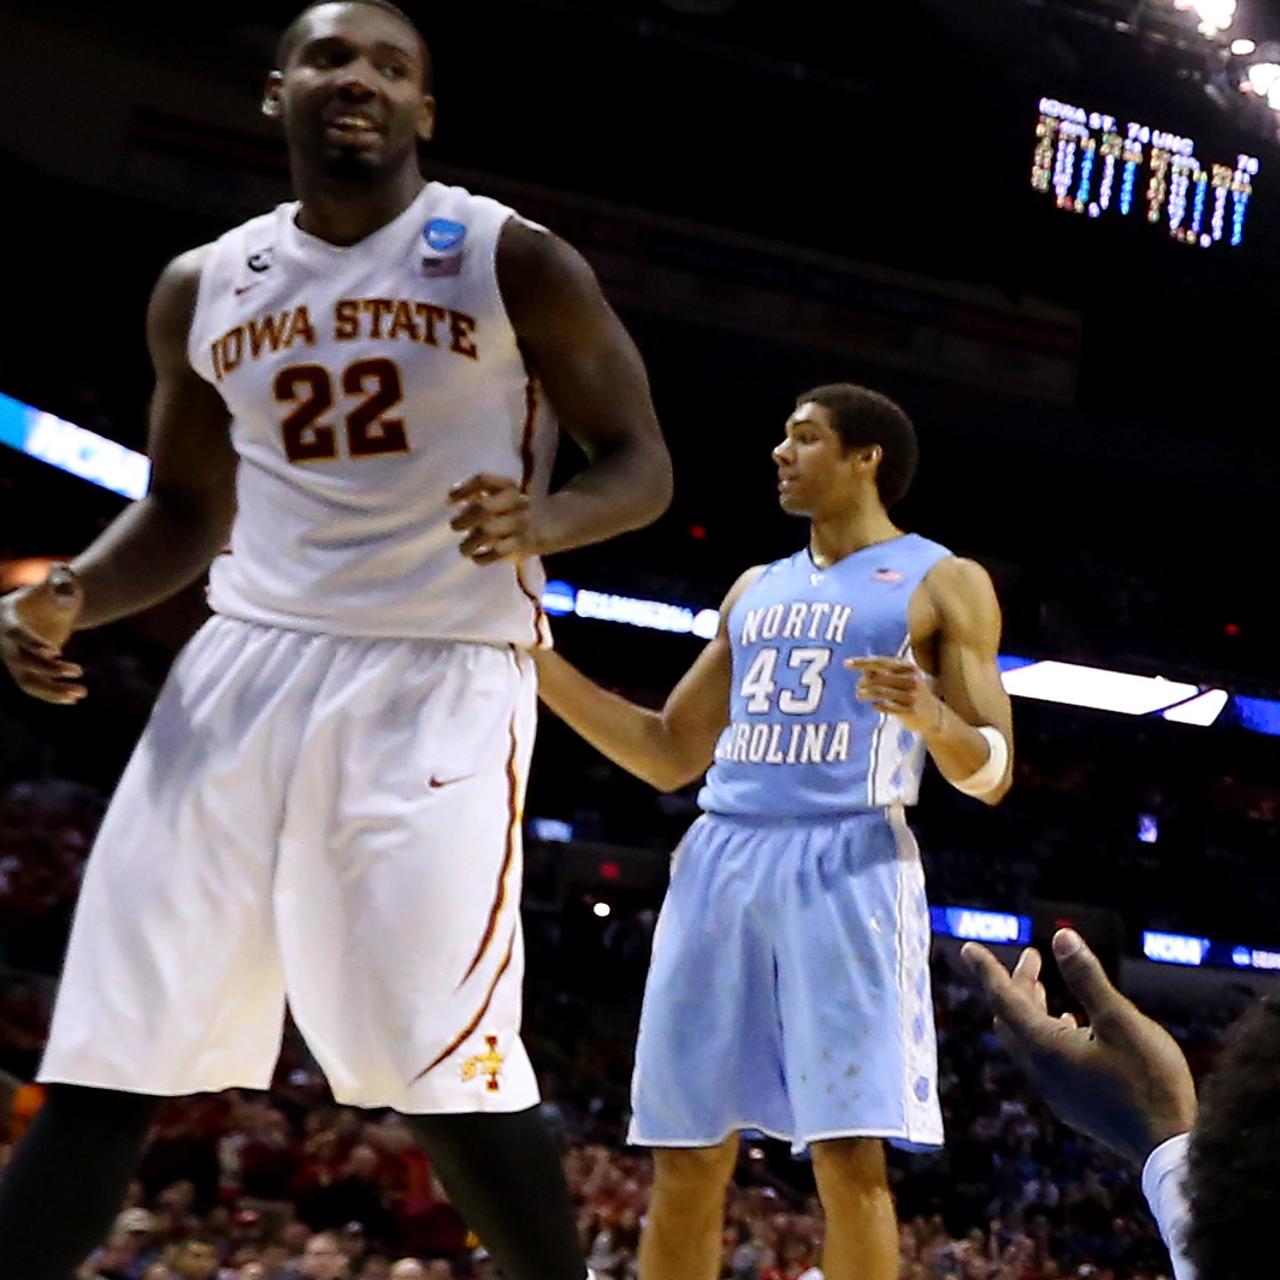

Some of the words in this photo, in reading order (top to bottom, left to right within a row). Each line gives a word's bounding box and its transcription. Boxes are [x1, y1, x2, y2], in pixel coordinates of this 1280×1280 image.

[210, 305, 316, 381] IOWA
[334, 297, 480, 361] STATE
[273, 357, 412, 463] 22
[741, 601, 852, 647] NORTH
[740, 647, 833, 717] 43
